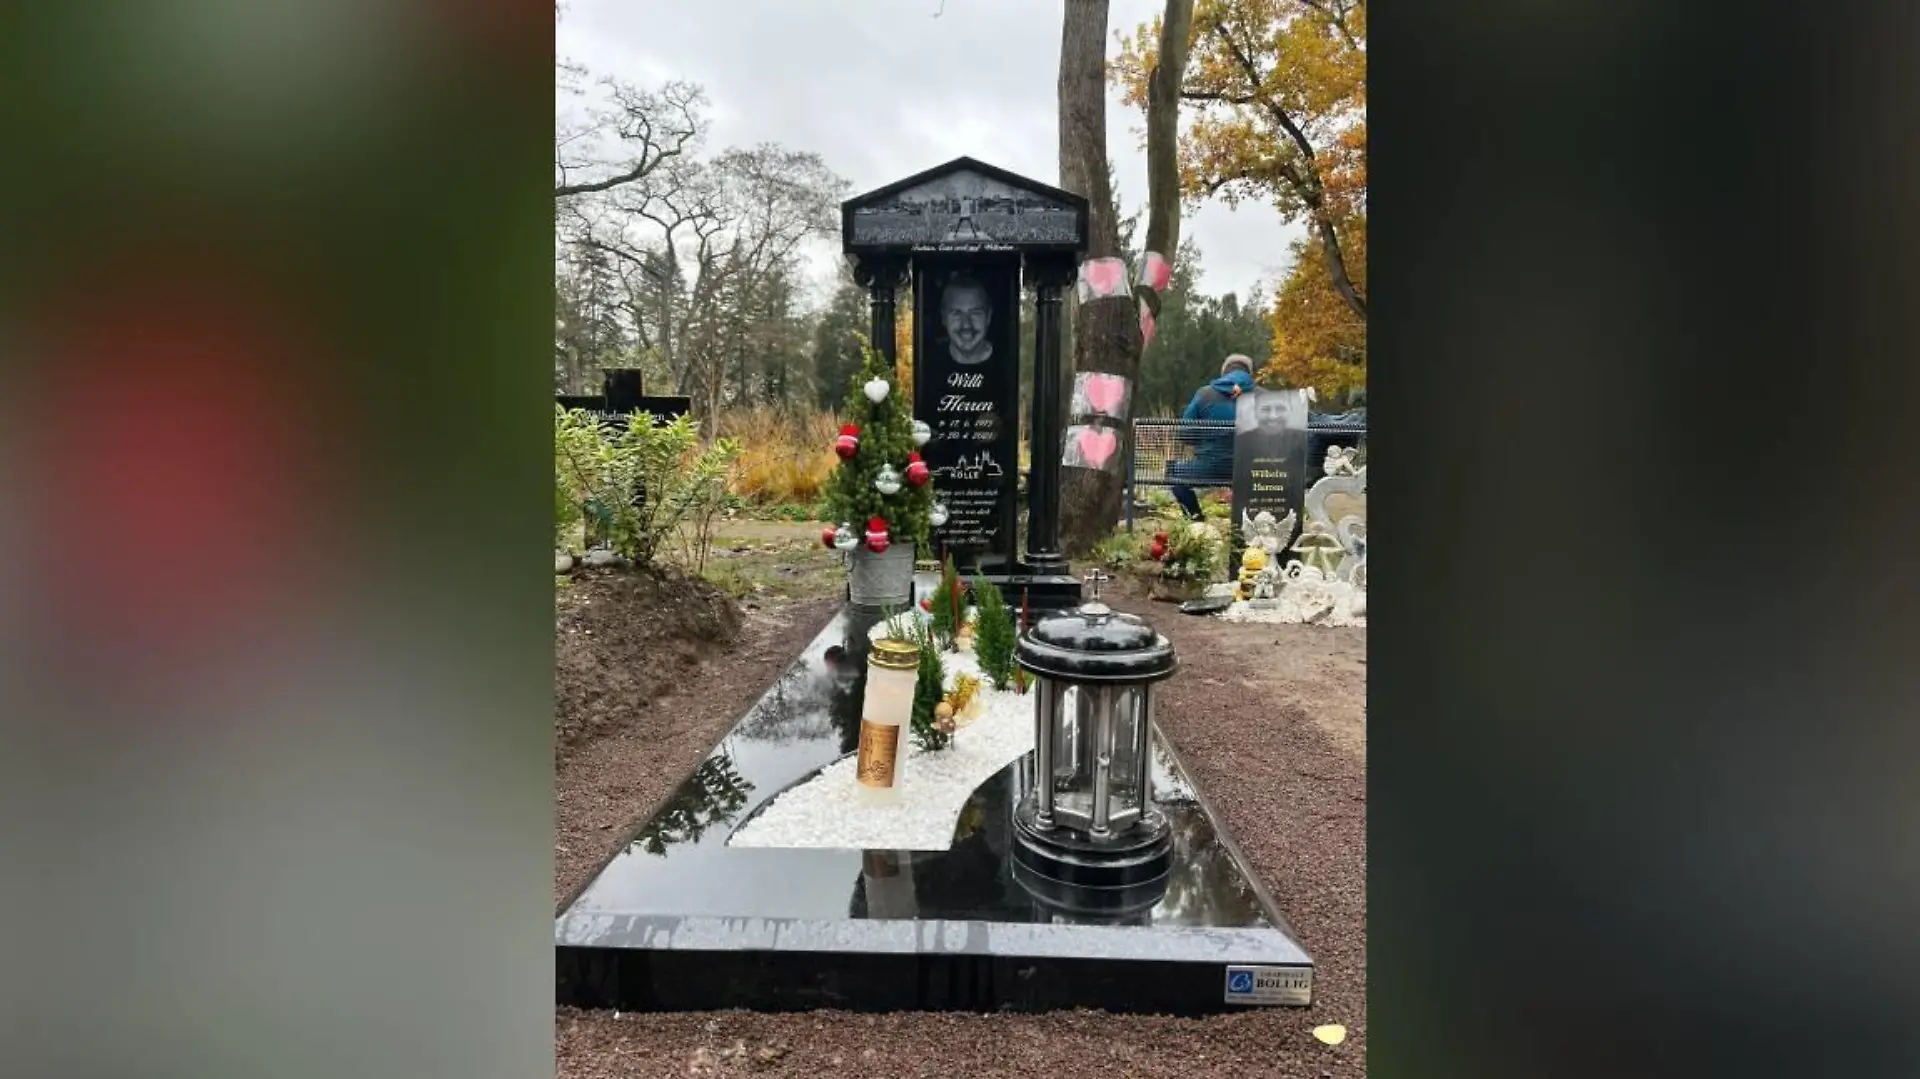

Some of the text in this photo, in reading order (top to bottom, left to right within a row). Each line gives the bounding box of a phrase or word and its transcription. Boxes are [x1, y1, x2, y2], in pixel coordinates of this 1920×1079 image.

[947, 372, 984, 388] Willi
[937, 394, 993, 411] Herren
[1256, 979, 1309, 989] BOLLIG
